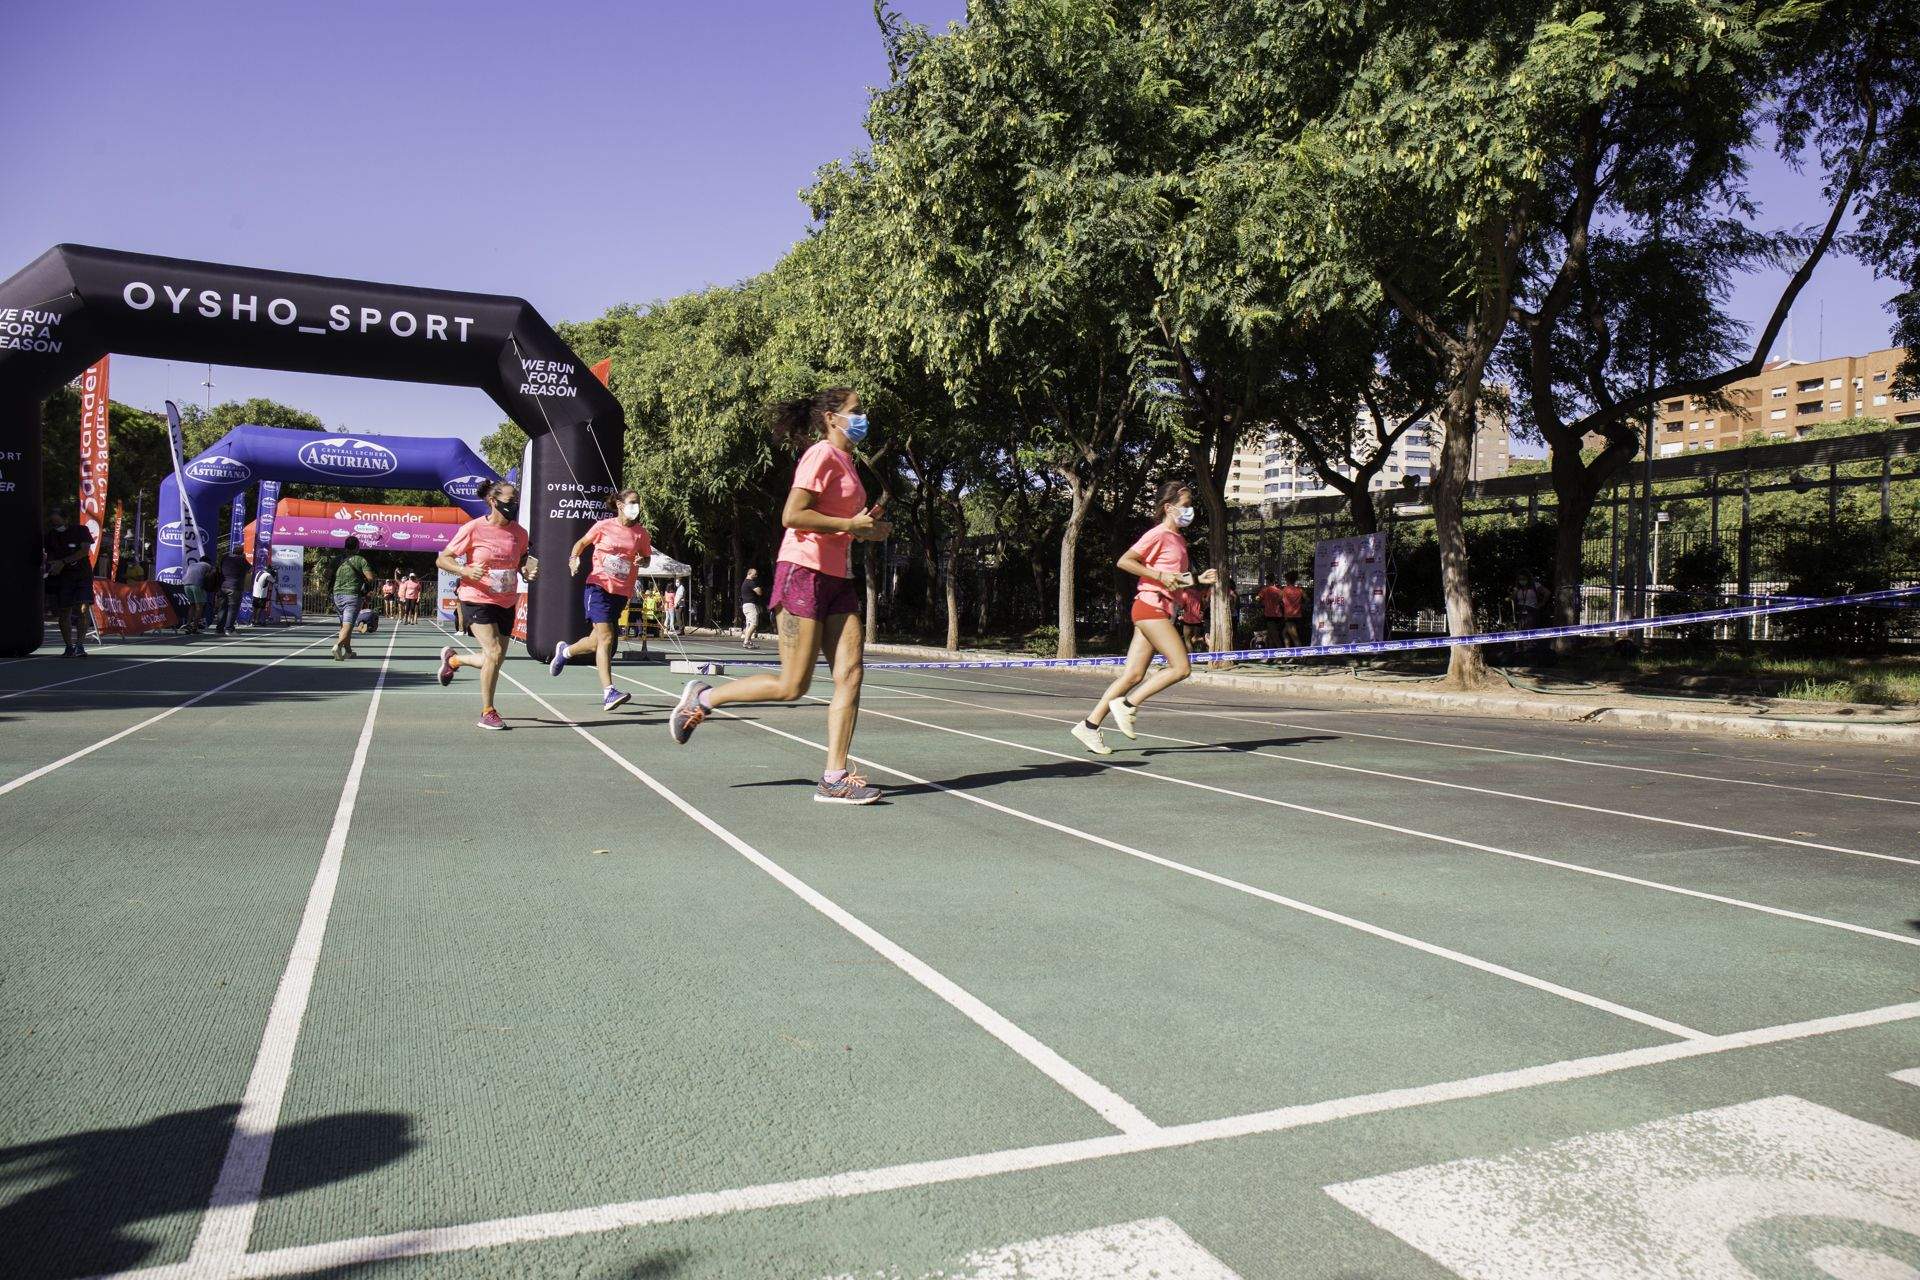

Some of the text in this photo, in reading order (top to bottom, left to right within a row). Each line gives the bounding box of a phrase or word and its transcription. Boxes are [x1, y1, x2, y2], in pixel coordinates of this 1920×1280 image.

[123, 281, 474, 342] OYSHO_SPORT
[21, 311, 62, 326] RUN
[38, 326, 51, 338] A
[0, 336, 63, 353] EASON
[521, 359, 575, 375] WE RUN
[528, 372, 569, 385] FOR A
[519, 384, 577, 398] REASON
[321, 447, 354, 456] CENTRAL
[306, 447, 390, 470] ASTURIANA
[189, 465, 246, 479] ASTURIANA
[547, 483, 615, 495] OYSHO_SPOR
[558, 498, 608, 510] CARRERA
[353, 510, 424, 523] Santander
[549, 509, 614, 521] DE LA MUJER
